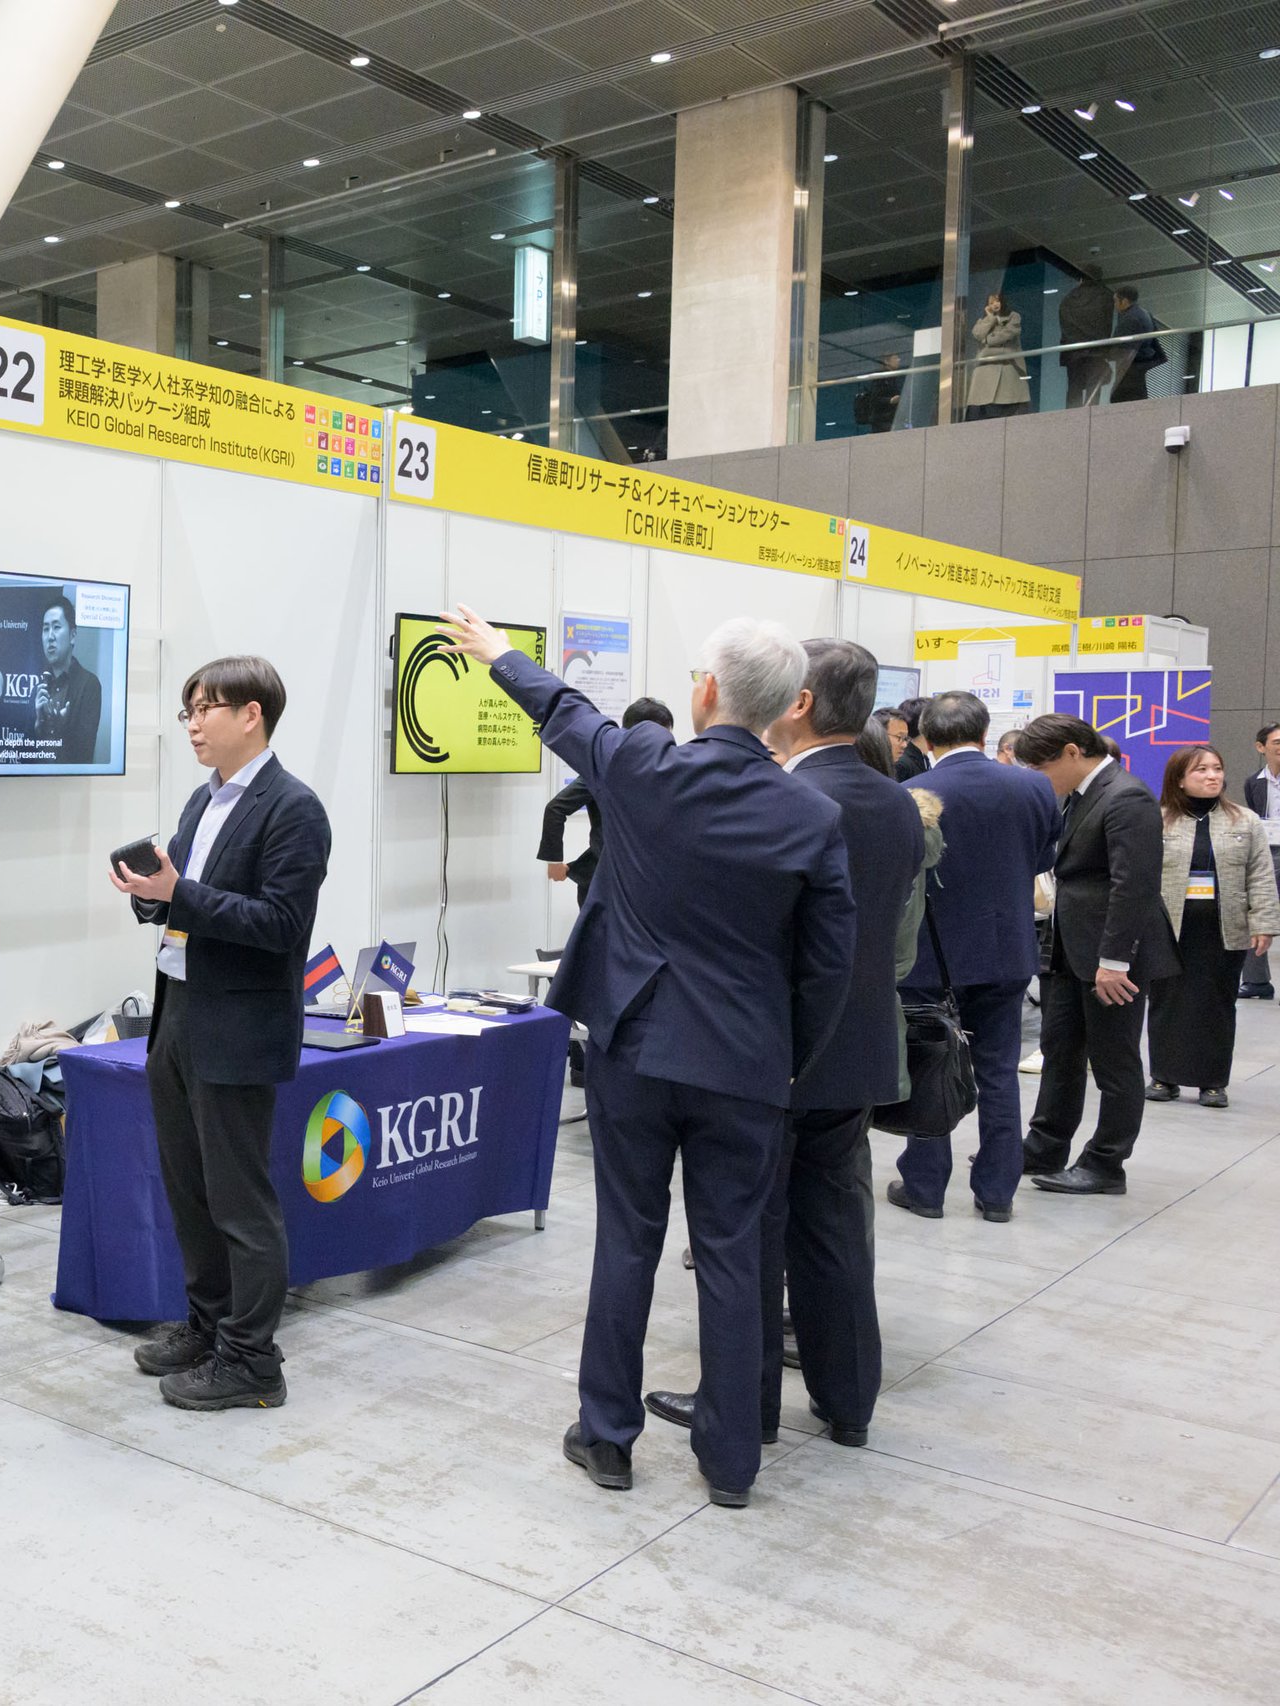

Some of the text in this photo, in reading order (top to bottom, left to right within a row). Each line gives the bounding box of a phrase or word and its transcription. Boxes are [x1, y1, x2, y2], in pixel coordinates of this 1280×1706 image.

[58, 376, 211, 428] 課題解決パッケージ組成
[67, 408, 296, 468] KEIO Global Research Institute(KGRI)
[397, 438, 430, 481] 23
[625, 509, 714, 551] 「CRIK信濃町」
[850, 537, 866, 567] 24
[3, 620, 29, 631] University
[5, 673, 44, 697] KGR
[19, 750, 57, 760] researchers,
[24, 738, 35, 746] the
[35, 739, 63, 748] personal
[390, 962, 408, 982] KGRI
[376, 1086, 484, 1169] KGRI
[372, 1177, 389, 1188] Keio
[415, 1160, 434, 1175] Global
[434, 1156, 458, 1170] Research
